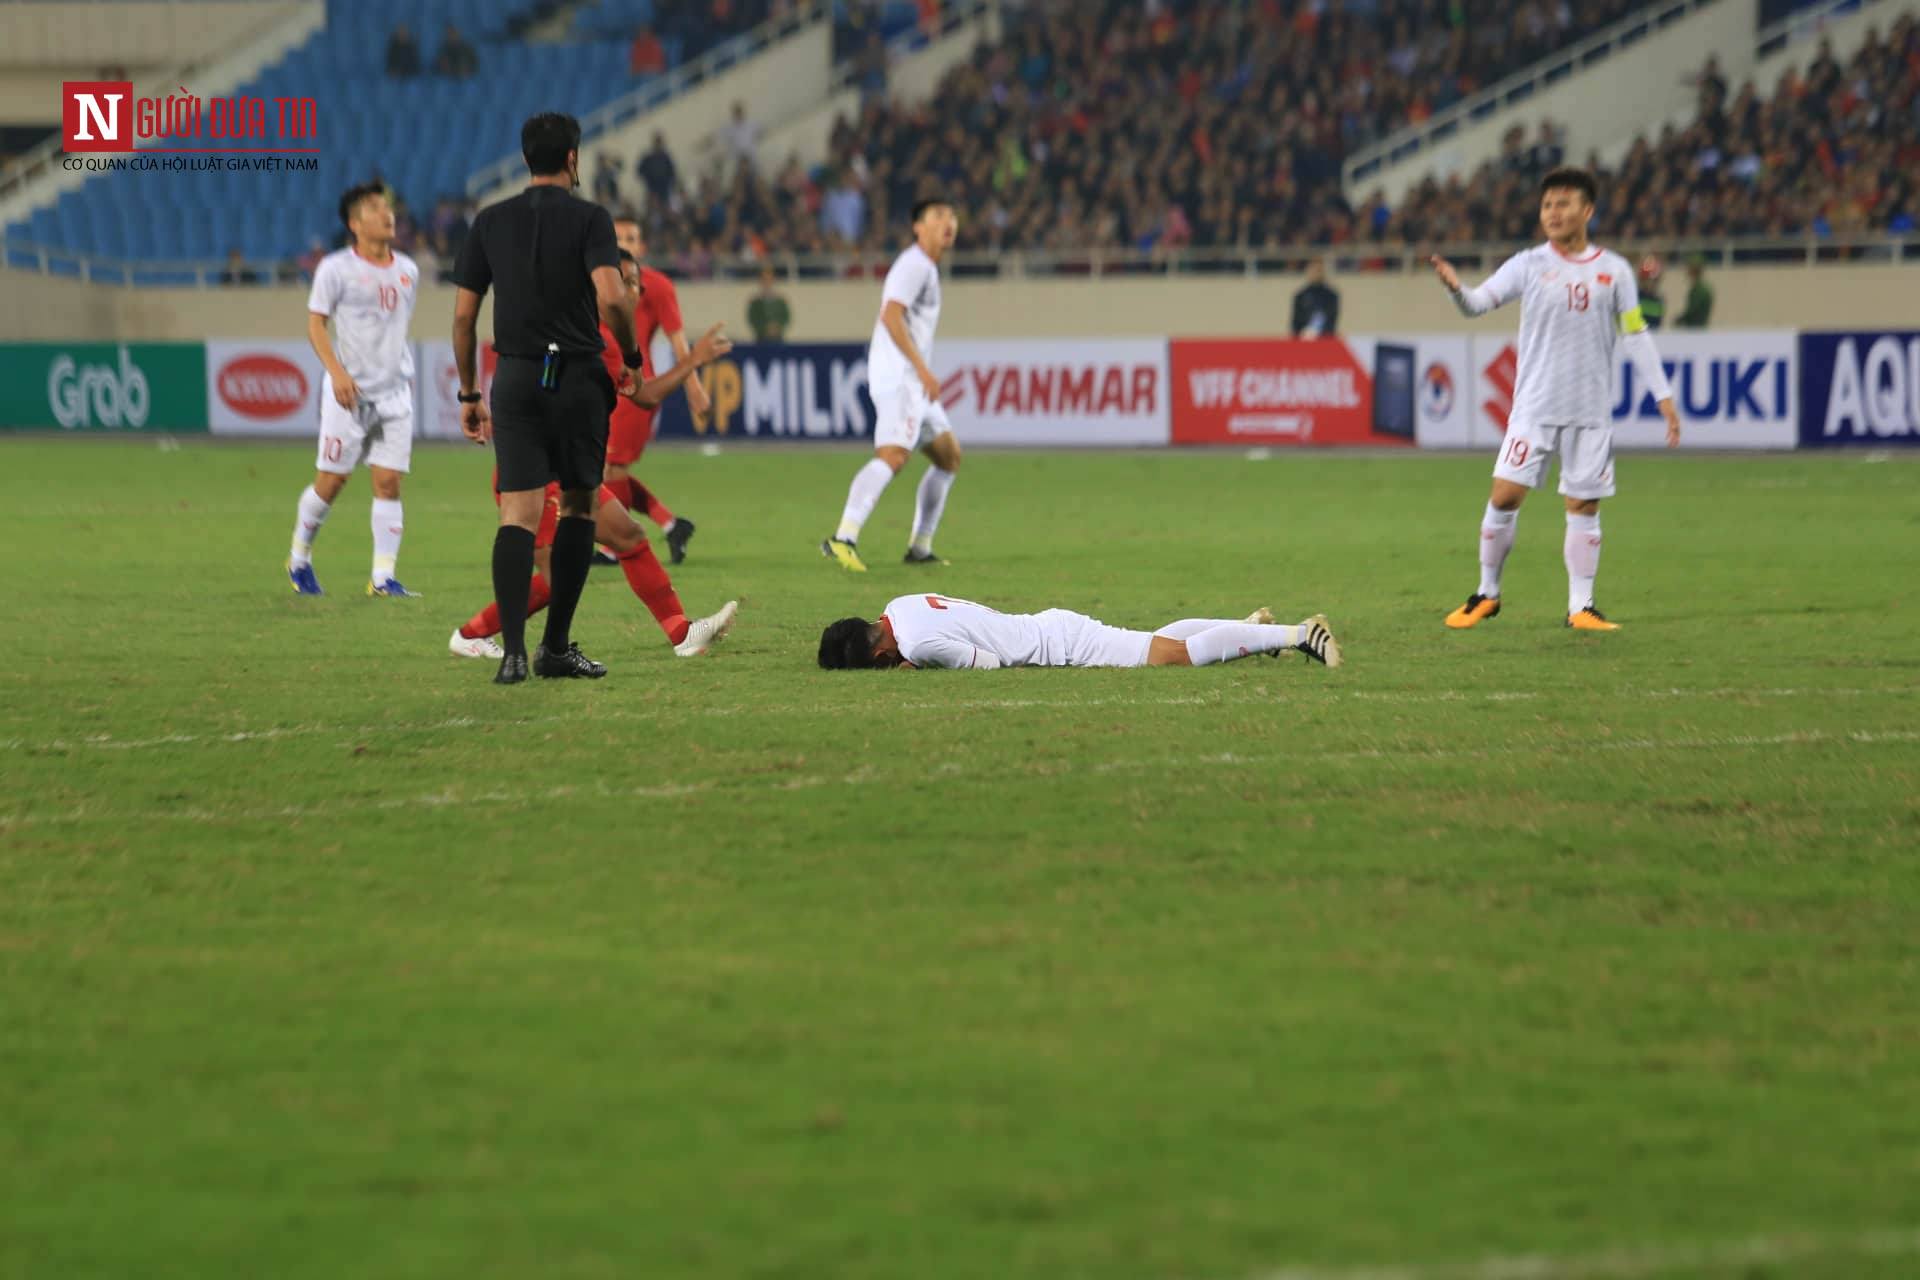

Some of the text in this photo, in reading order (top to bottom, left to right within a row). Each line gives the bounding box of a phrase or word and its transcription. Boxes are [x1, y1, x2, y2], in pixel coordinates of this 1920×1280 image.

[378, 284, 398, 313] 10
[1564, 282, 1590, 313] 19
[48, 344, 151, 428] Grab
[971, 363, 1158, 415] YANMAR
[323, 434, 343, 464] 10
[1503, 438, 1529, 467] 19
